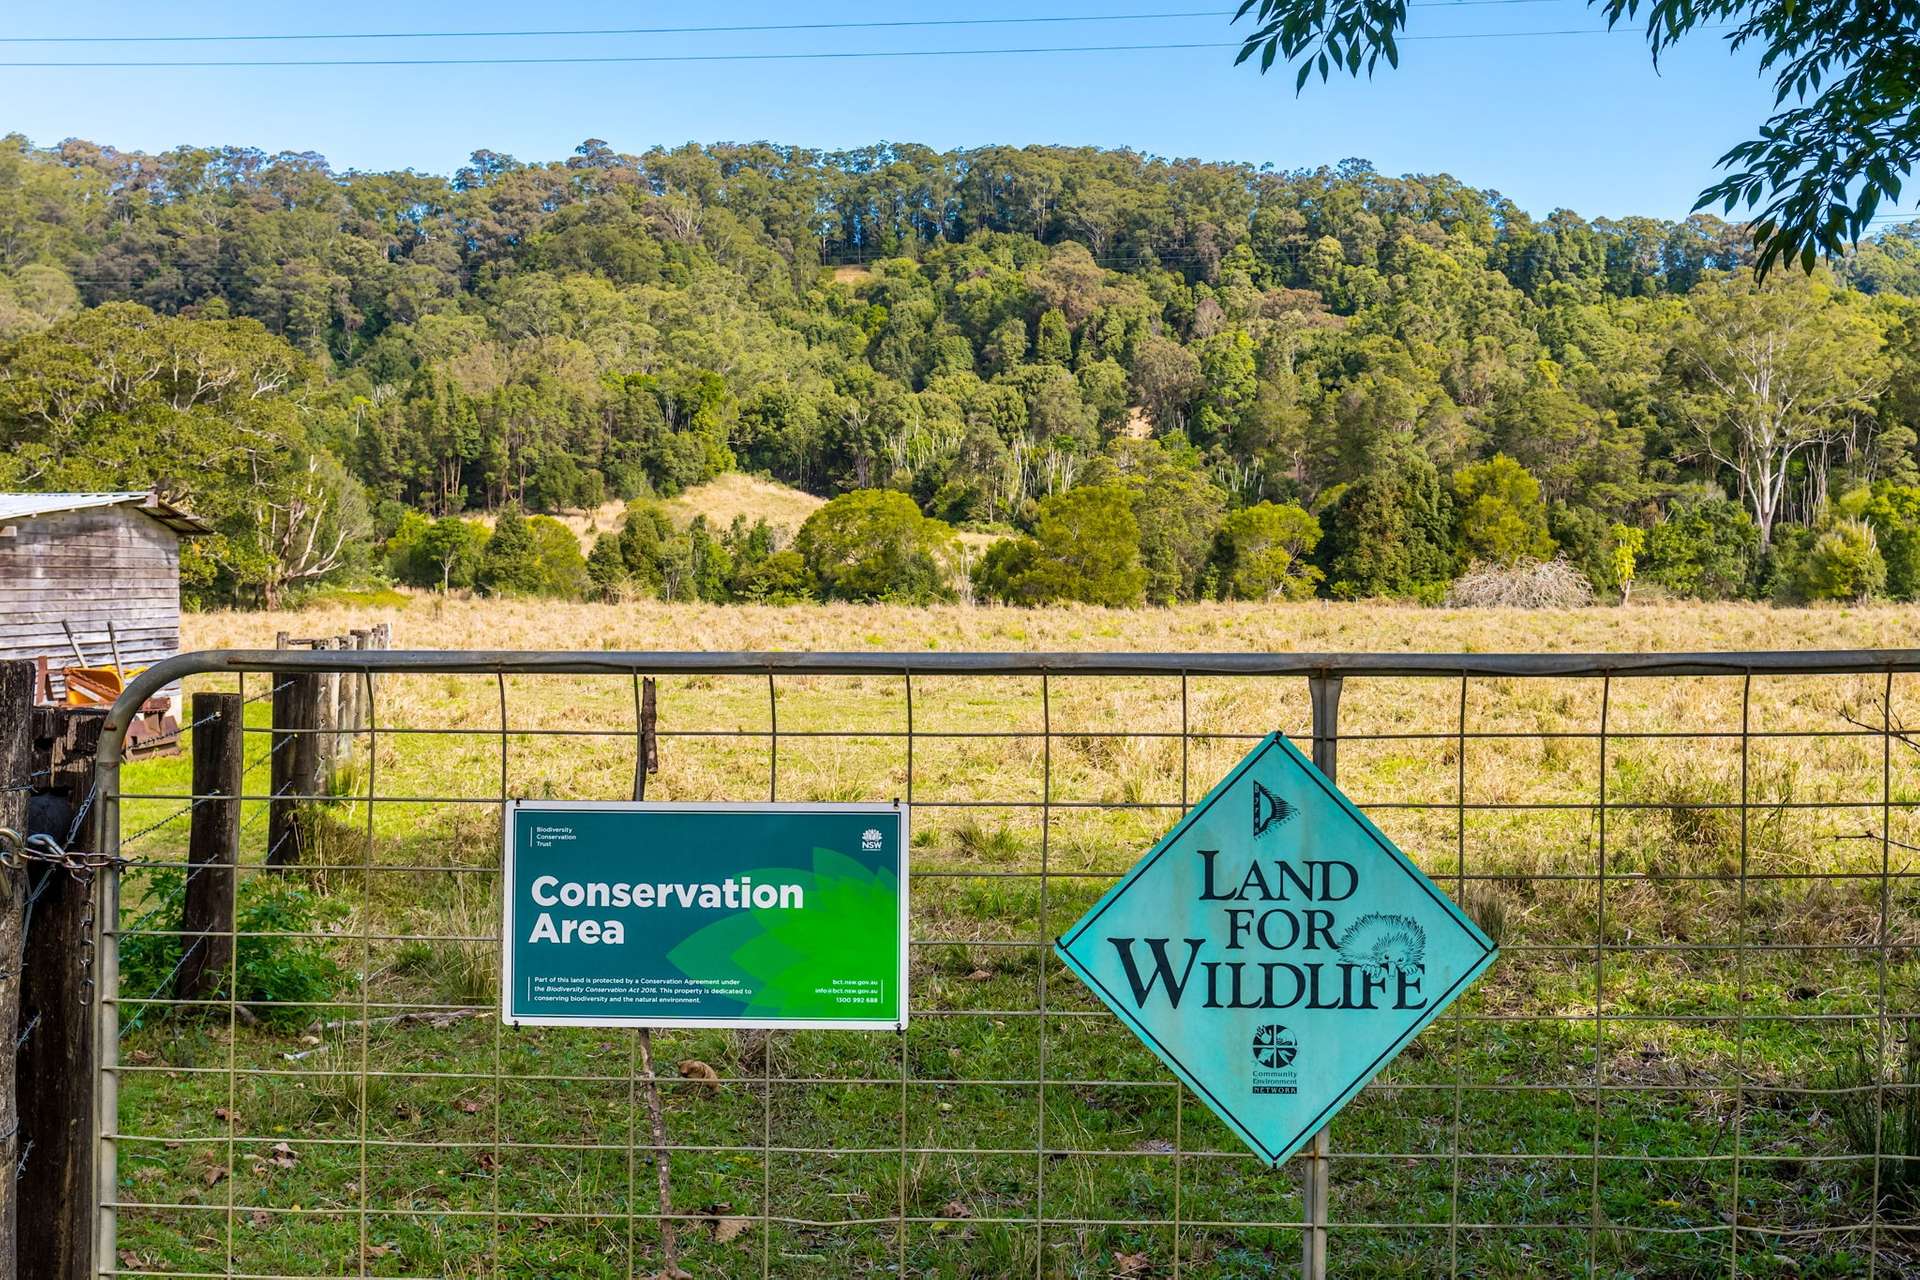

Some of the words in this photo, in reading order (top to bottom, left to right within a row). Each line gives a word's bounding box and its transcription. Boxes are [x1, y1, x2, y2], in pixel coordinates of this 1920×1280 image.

[530, 875, 804, 909] Conservation
[1196, 849, 1360, 902] LAND
[527, 912, 625, 945] Area
[1223, 907, 1339, 951] FOR
[1106, 936, 1429, 1011] WILDLIFE
